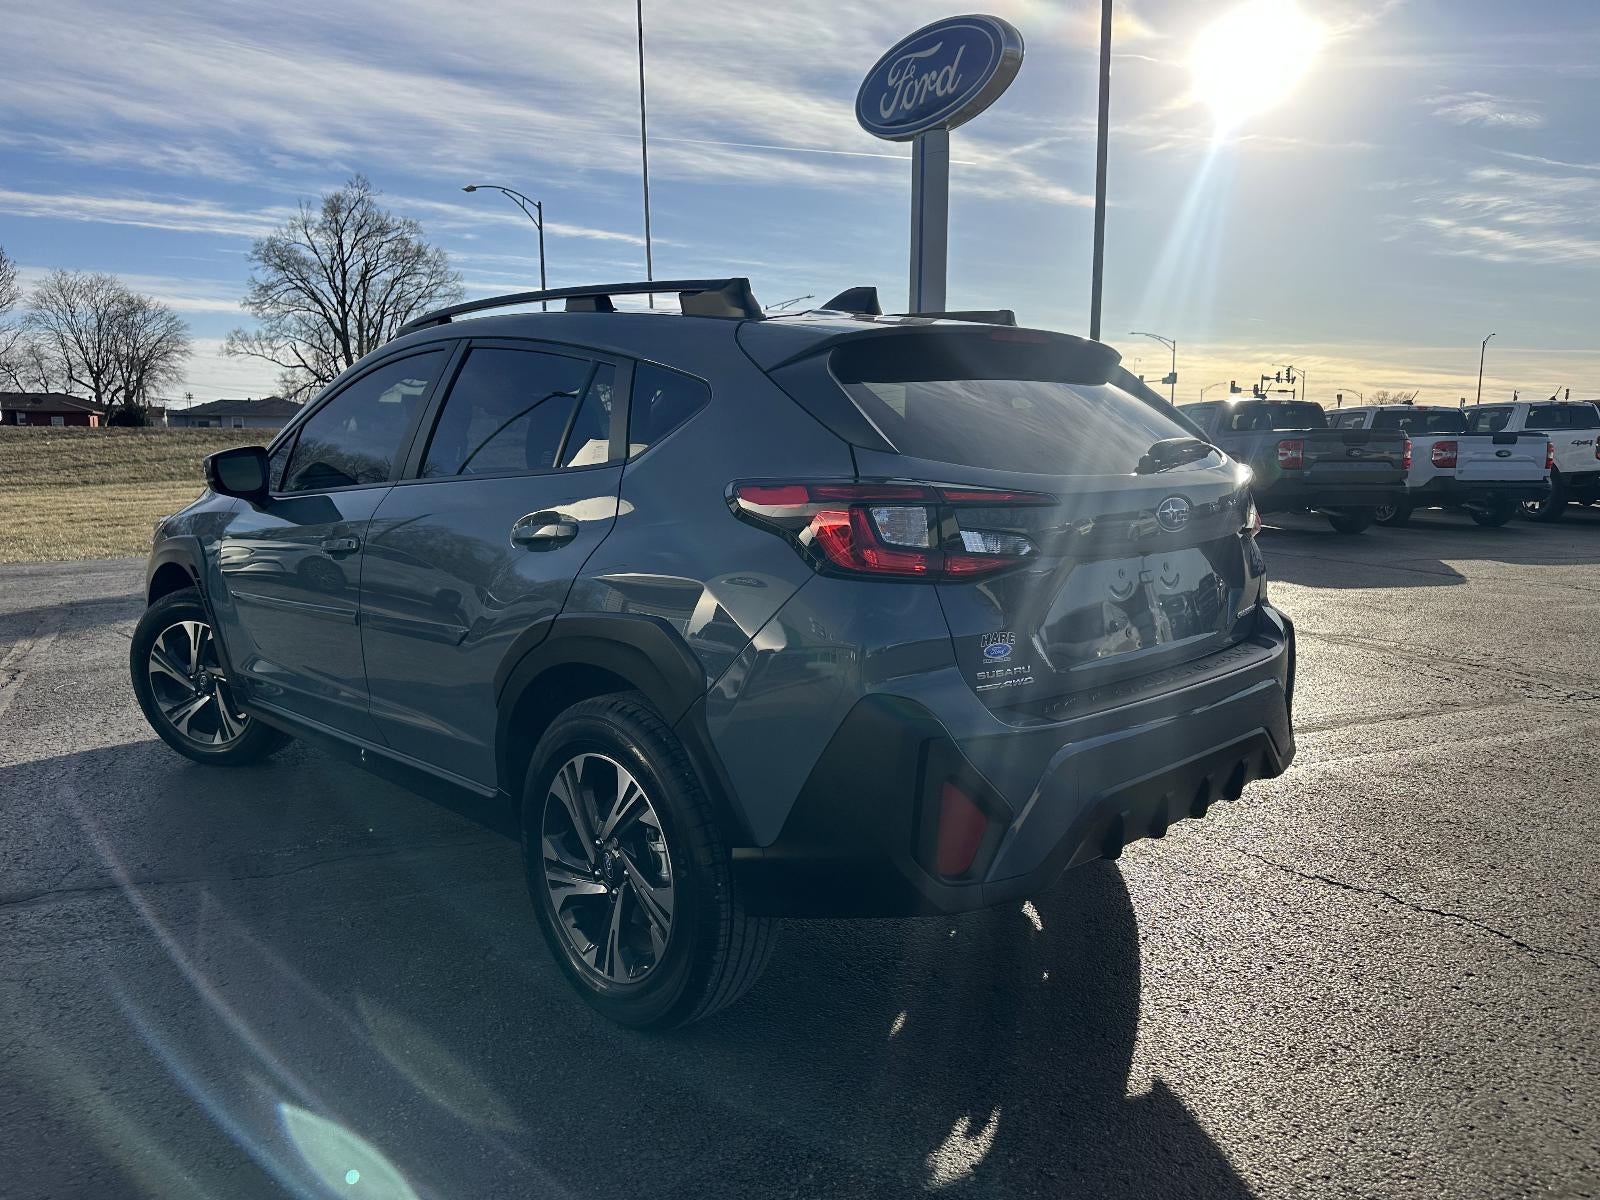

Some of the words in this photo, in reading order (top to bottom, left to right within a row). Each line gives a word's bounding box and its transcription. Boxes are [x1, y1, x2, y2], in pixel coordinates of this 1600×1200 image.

[879, 41, 966, 119] Ford
[980, 631, 1016, 648] HARE
[976, 665, 1031, 680] SUBARU
